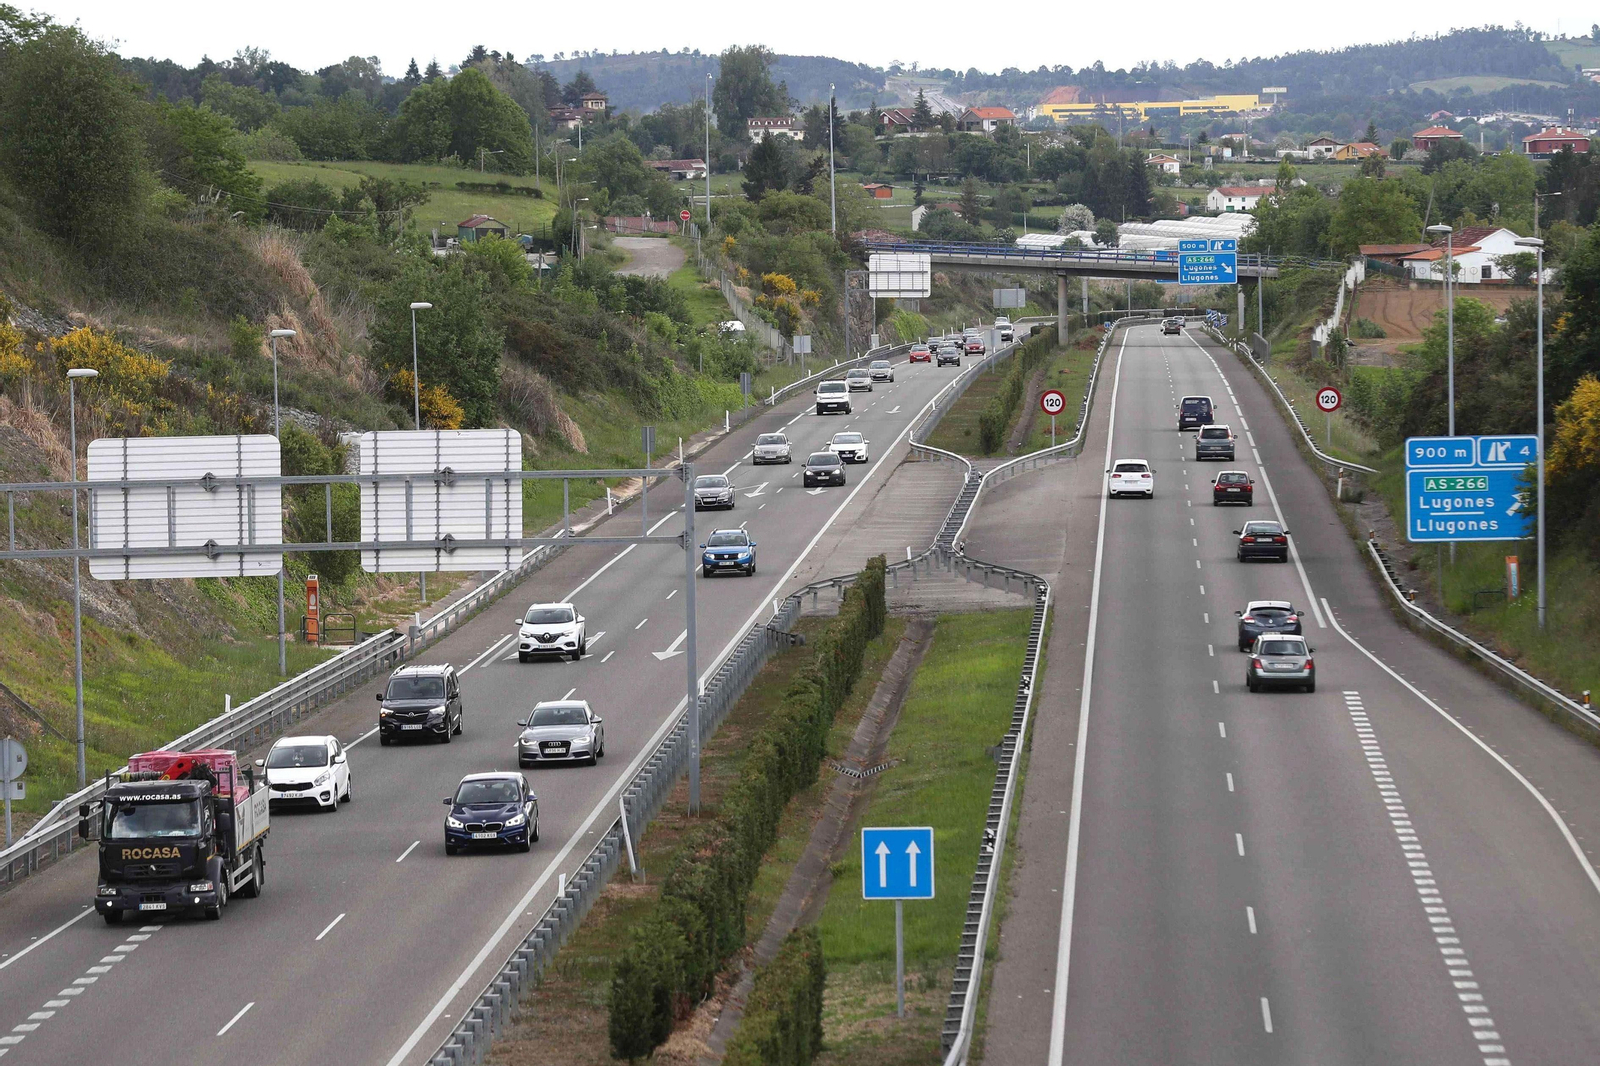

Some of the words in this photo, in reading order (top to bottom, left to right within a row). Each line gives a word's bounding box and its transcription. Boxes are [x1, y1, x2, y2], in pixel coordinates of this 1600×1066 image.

[1045, 398, 1061, 407] 120
[1321, 395, 1336, 404] 120
[1415, 447, 1447, 458] 900
[1454, 448, 1467, 458] m
[1519, 445, 1530, 456] 4
[1427, 479, 1486, 489] AS-266
[1420, 496, 1495, 511] Lugones
[1417, 519, 1498, 534] Llugones
[120, 793, 181, 801] www.rocasa.as
[122, 847, 181, 859] ROCASA
